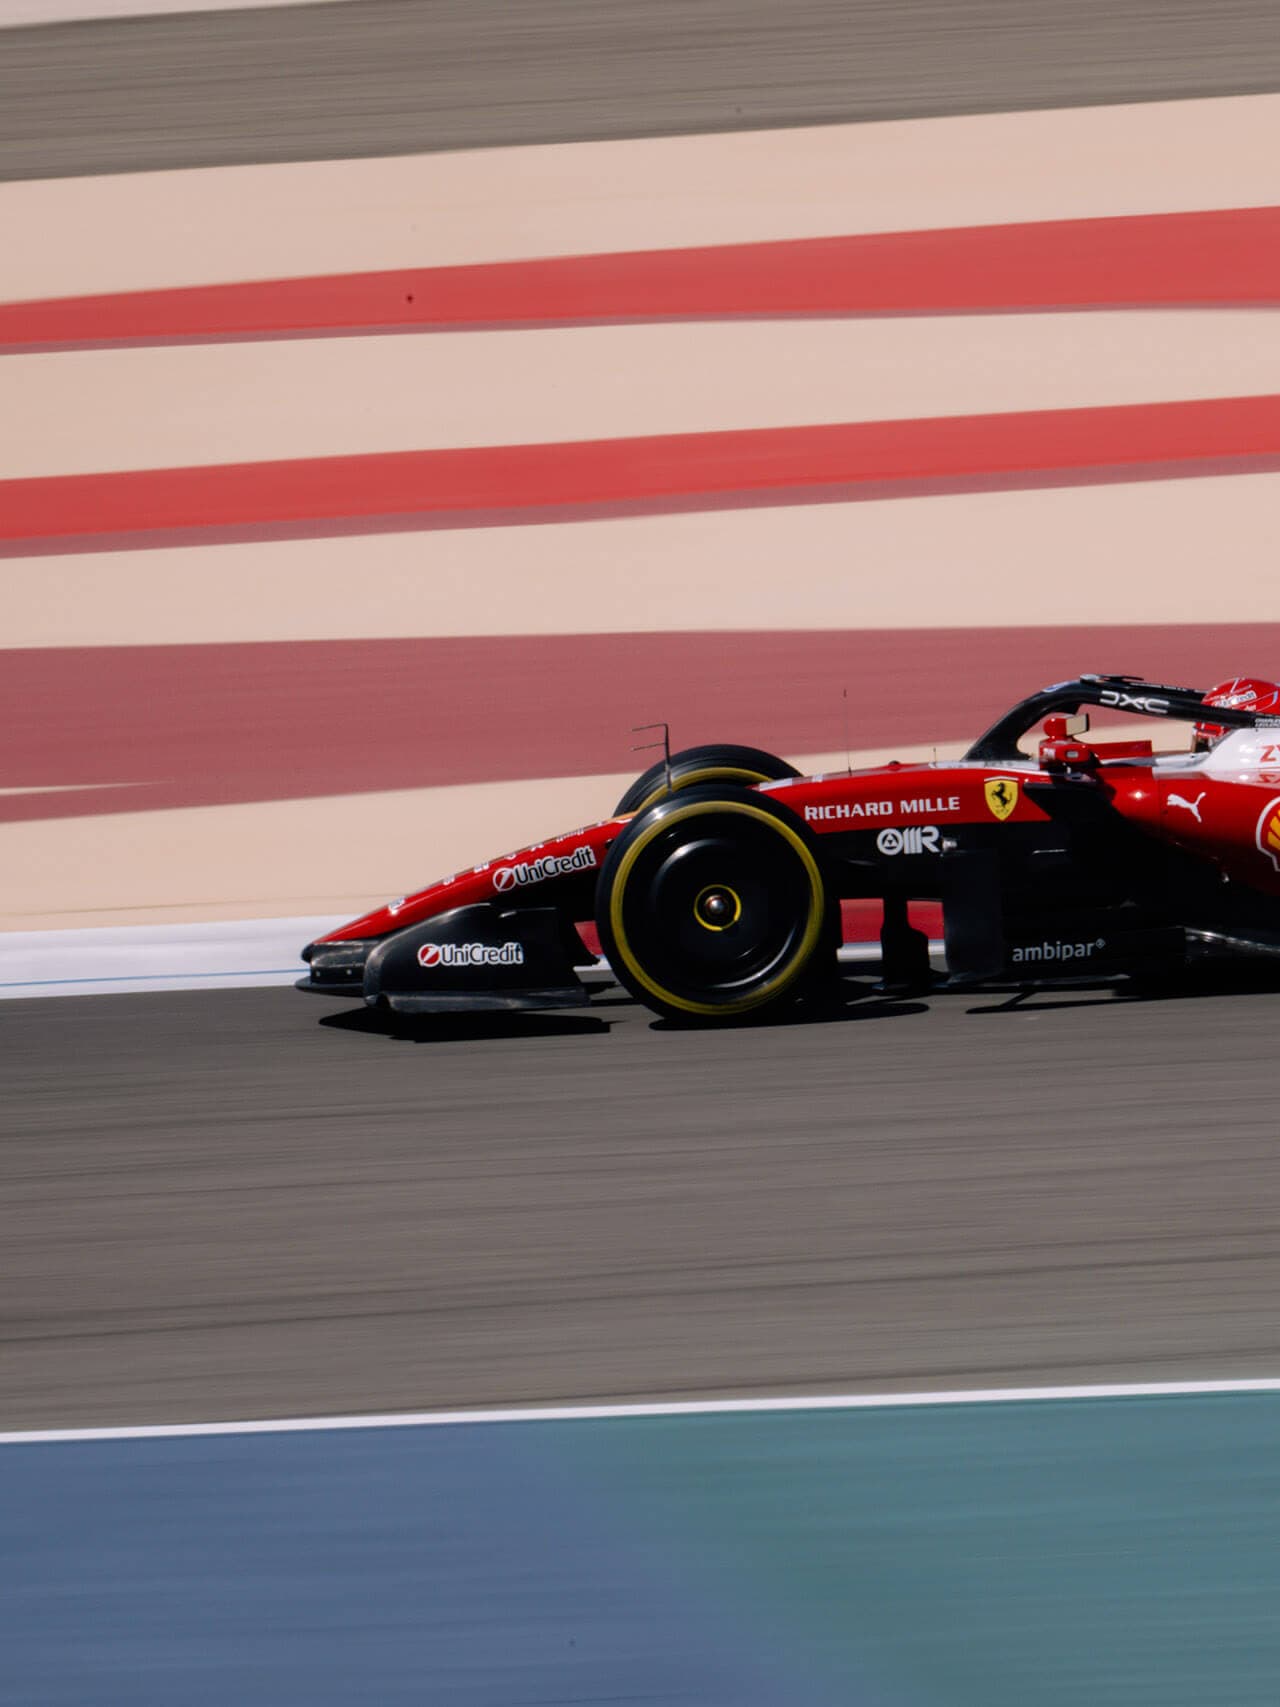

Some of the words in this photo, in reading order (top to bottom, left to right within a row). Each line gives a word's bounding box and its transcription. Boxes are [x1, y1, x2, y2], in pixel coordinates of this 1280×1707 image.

[1100, 690, 1170, 714] DXC
[804, 801, 893, 820] RICHARD
[901, 797, 960, 814] MILLE
[514, 847, 595, 885] UniCredit
[441, 944, 522, 963] UniCredit
